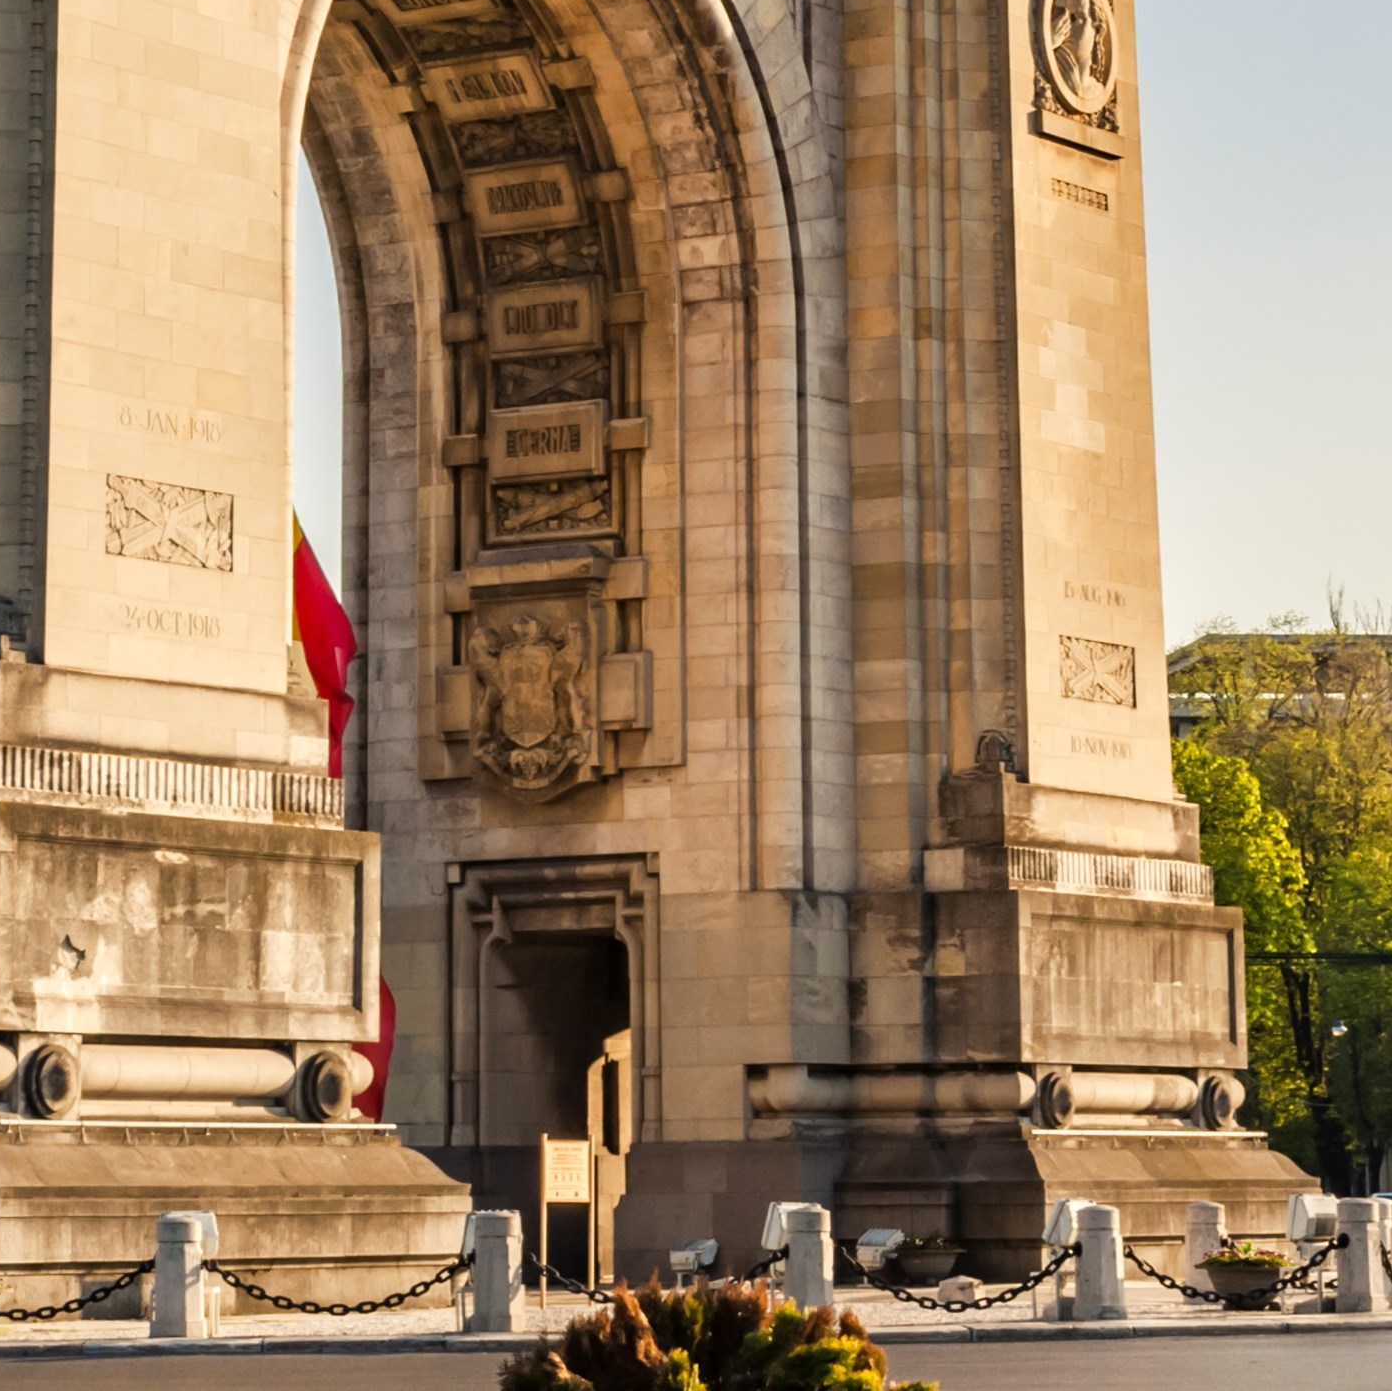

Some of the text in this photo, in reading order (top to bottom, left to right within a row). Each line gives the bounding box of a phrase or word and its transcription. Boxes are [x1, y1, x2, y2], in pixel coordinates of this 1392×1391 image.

[120, 405, 221, 444] 8 JAN 1918
[516, 424, 570, 458] CERNA
[1064, 580, 1075, 598] 15
[1080, 583, 1101, 604] AUG
[120, 603, 220, 639] 24 OCT 1918
[1070, 734, 1082, 754] 10
[1085, 736, 1109, 757] NOV
